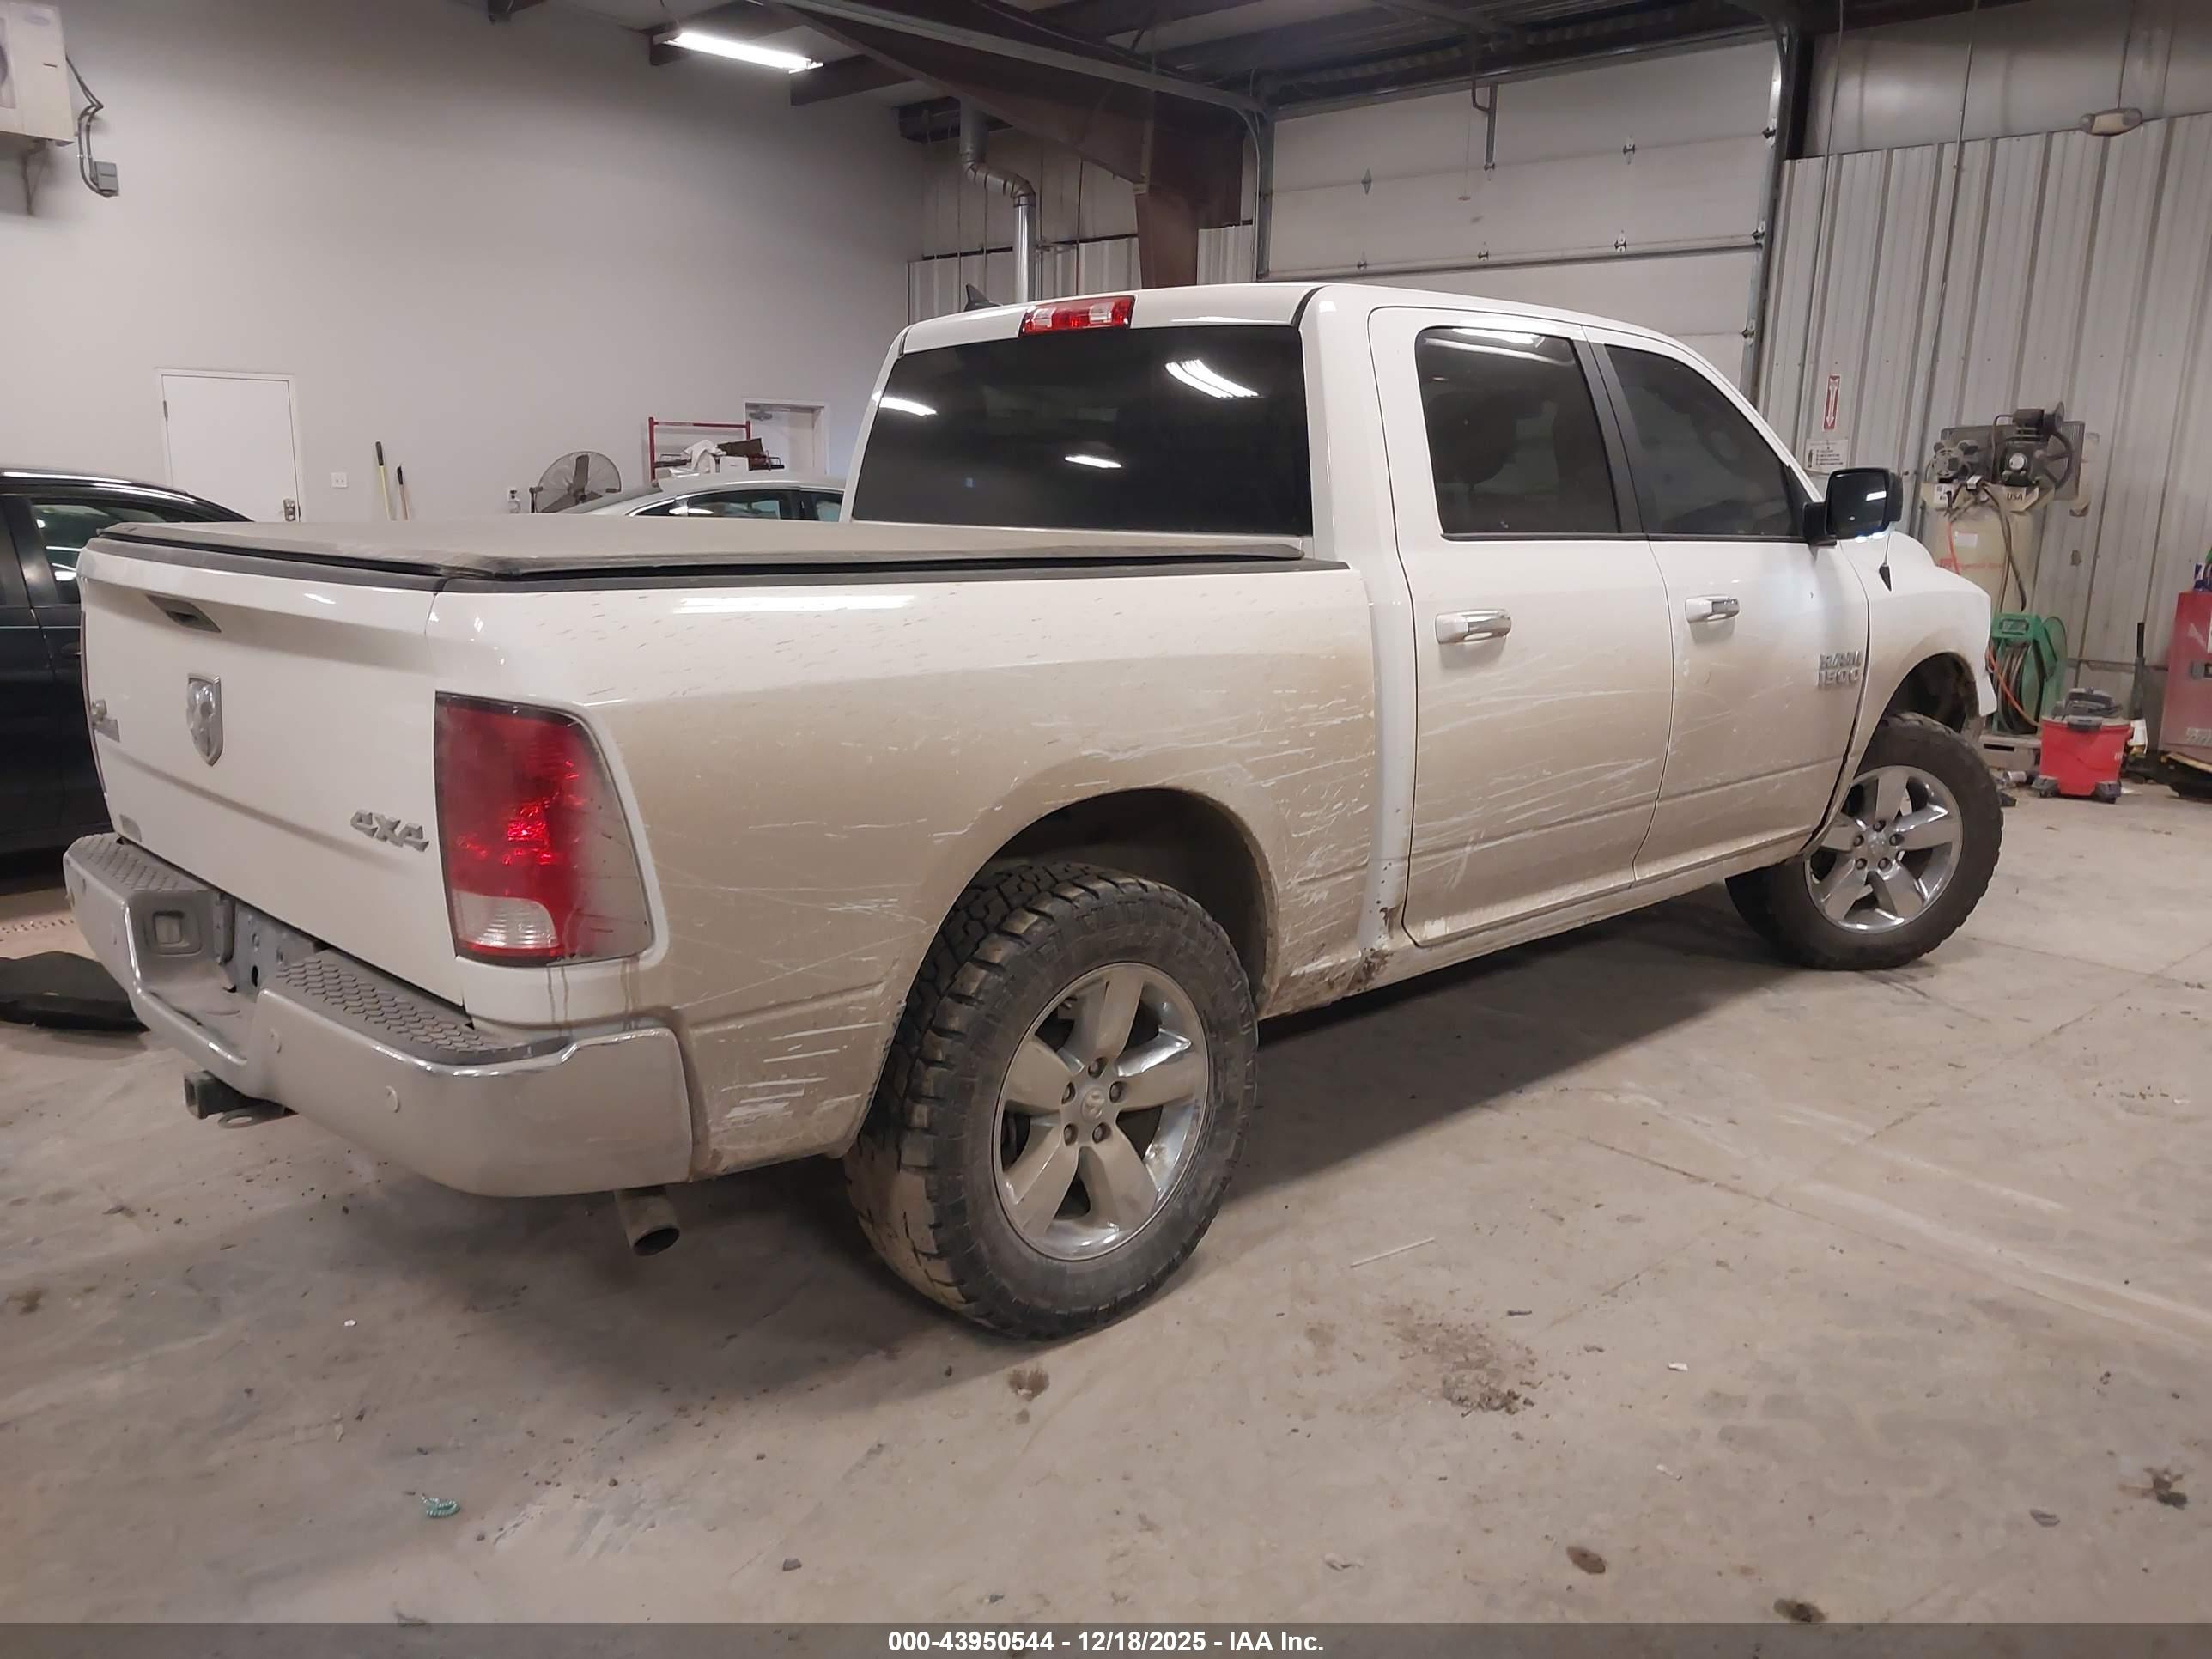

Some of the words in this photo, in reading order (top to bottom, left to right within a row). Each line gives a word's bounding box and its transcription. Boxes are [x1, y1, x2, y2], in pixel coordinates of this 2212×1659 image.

[2006, 492, 2024, 501] USA
[1818, 651, 1862, 670] RAM
[1816, 668, 1860, 688] 1500
